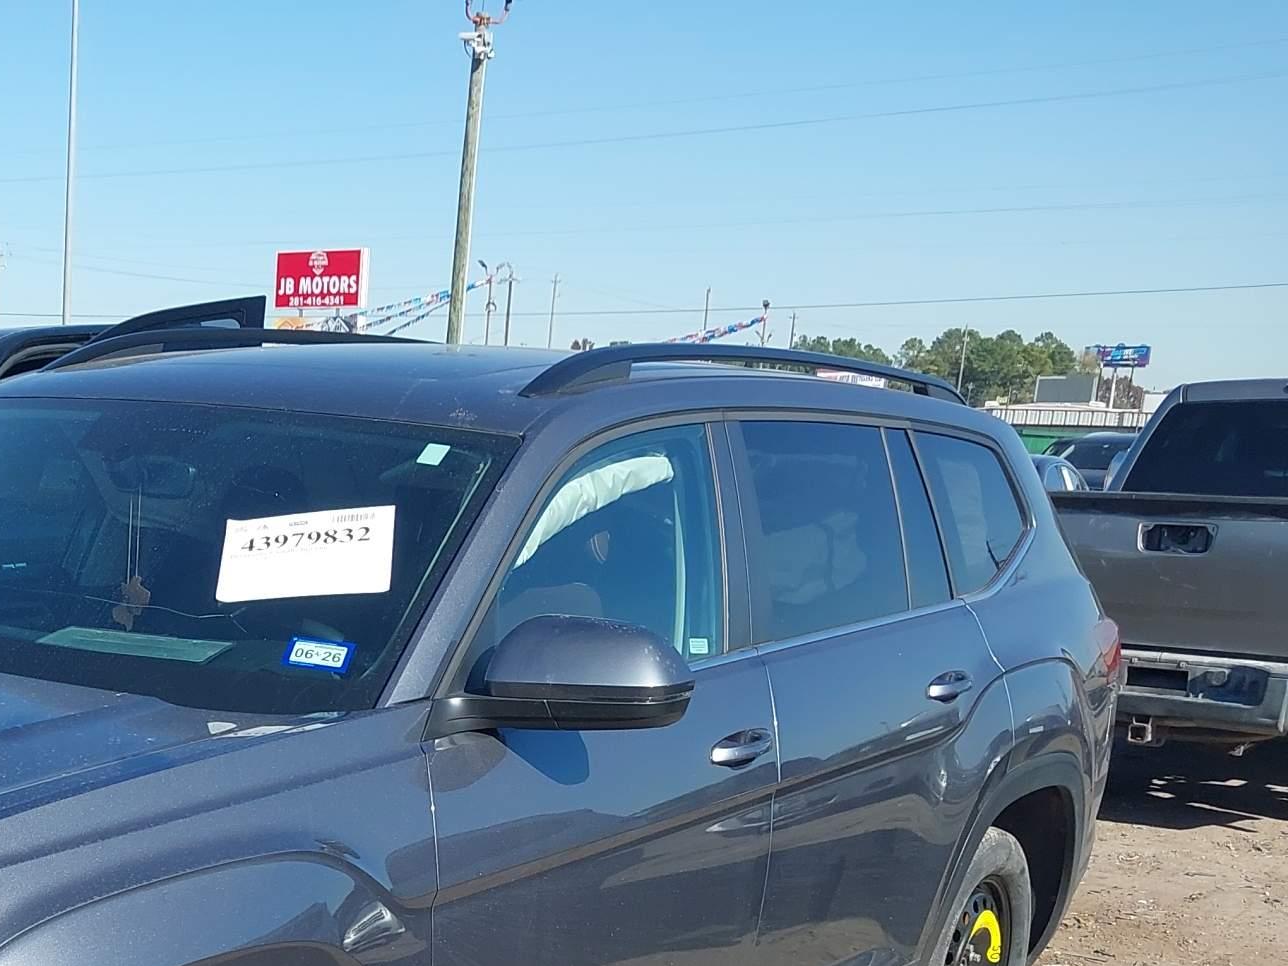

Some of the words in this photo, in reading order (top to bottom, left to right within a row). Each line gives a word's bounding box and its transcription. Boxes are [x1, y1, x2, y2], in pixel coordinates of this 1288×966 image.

[278, 277, 295, 295] JB
[299, 275, 357, 295] MOTORS
[241, 526, 371, 552] 43979832
